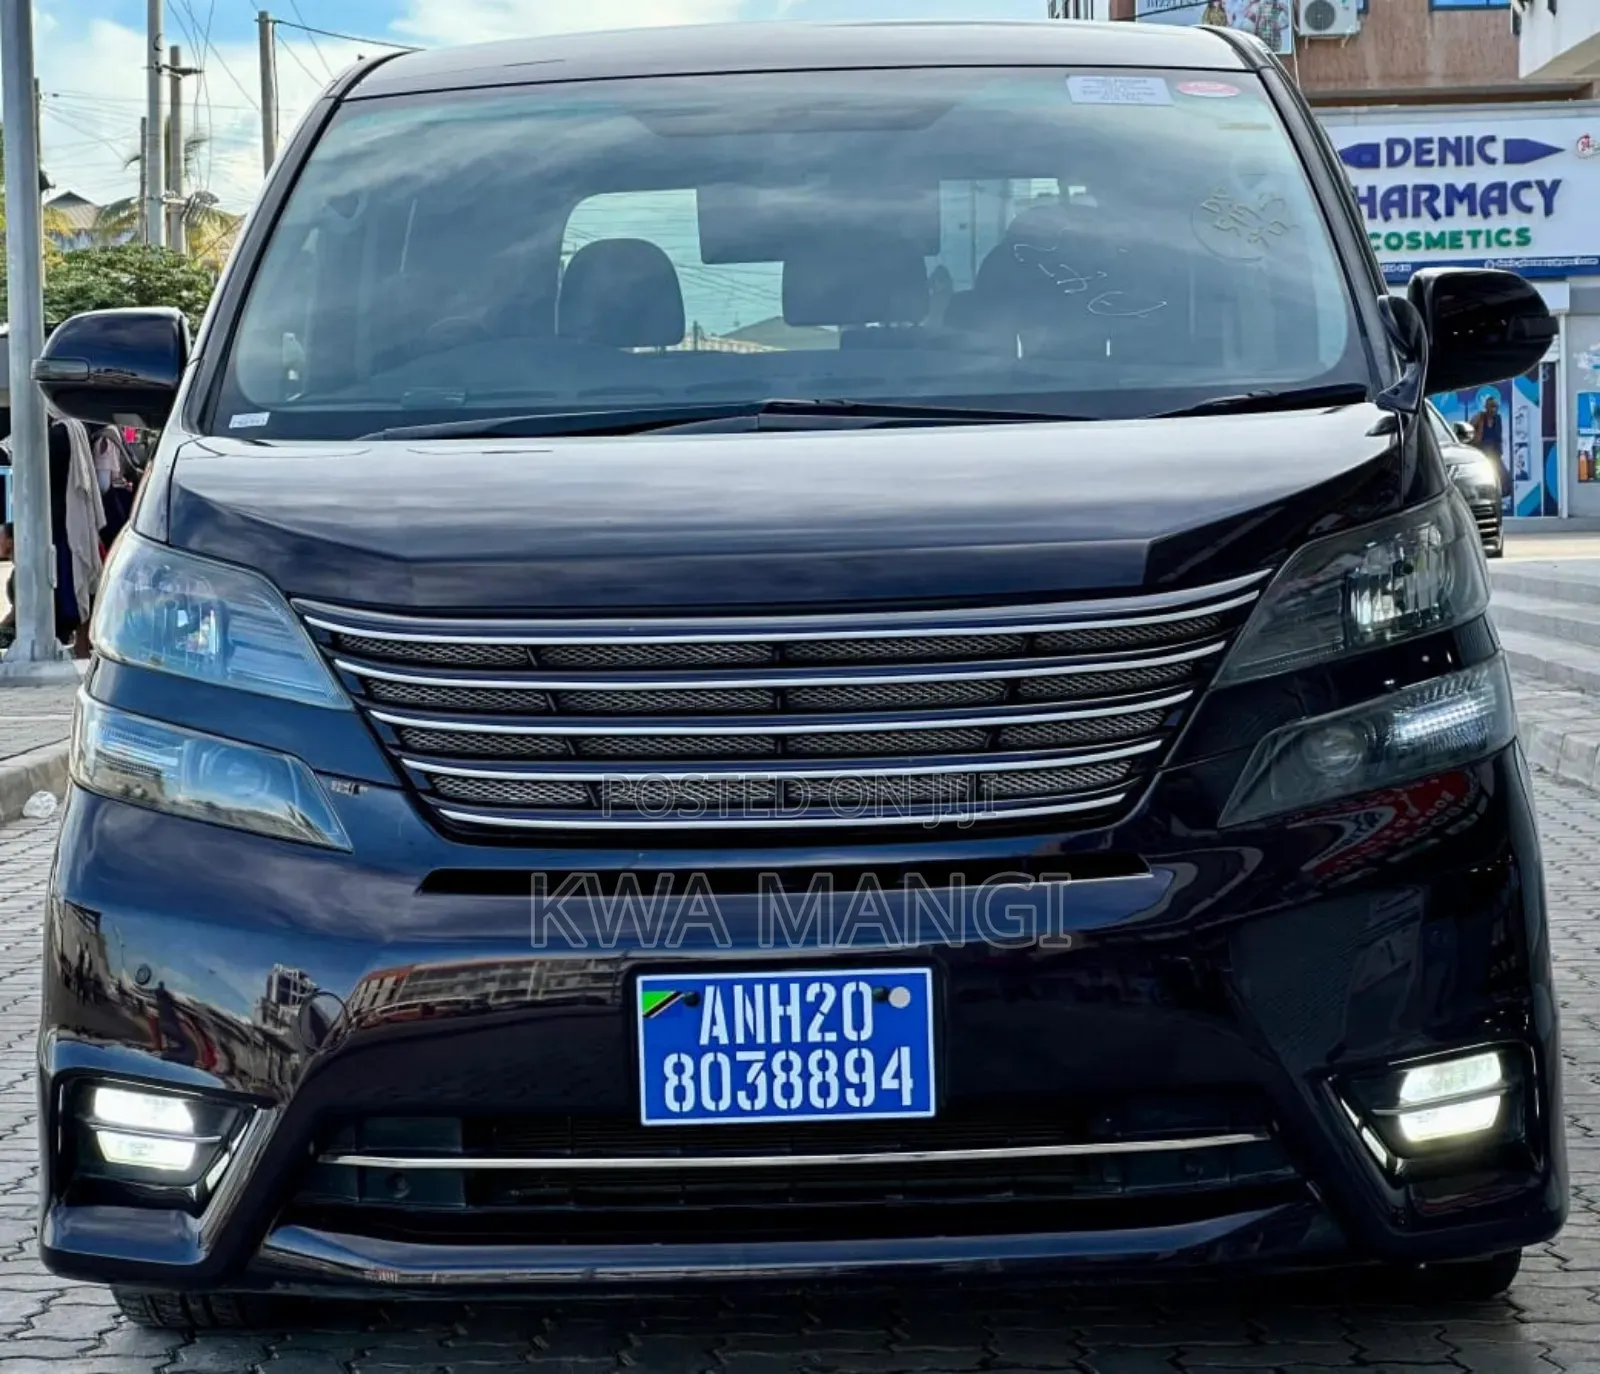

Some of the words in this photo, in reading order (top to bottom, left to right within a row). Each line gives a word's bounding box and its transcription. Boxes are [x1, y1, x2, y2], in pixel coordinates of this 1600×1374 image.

[1385, 135, 1497, 168] DENIC
[1352, 178, 1562, 222] HARMACY
[1369, 227, 1532, 251] COSMETICS
[699, 981, 874, 1046] ANH20
[663, 1046, 914, 1113] 8038894
